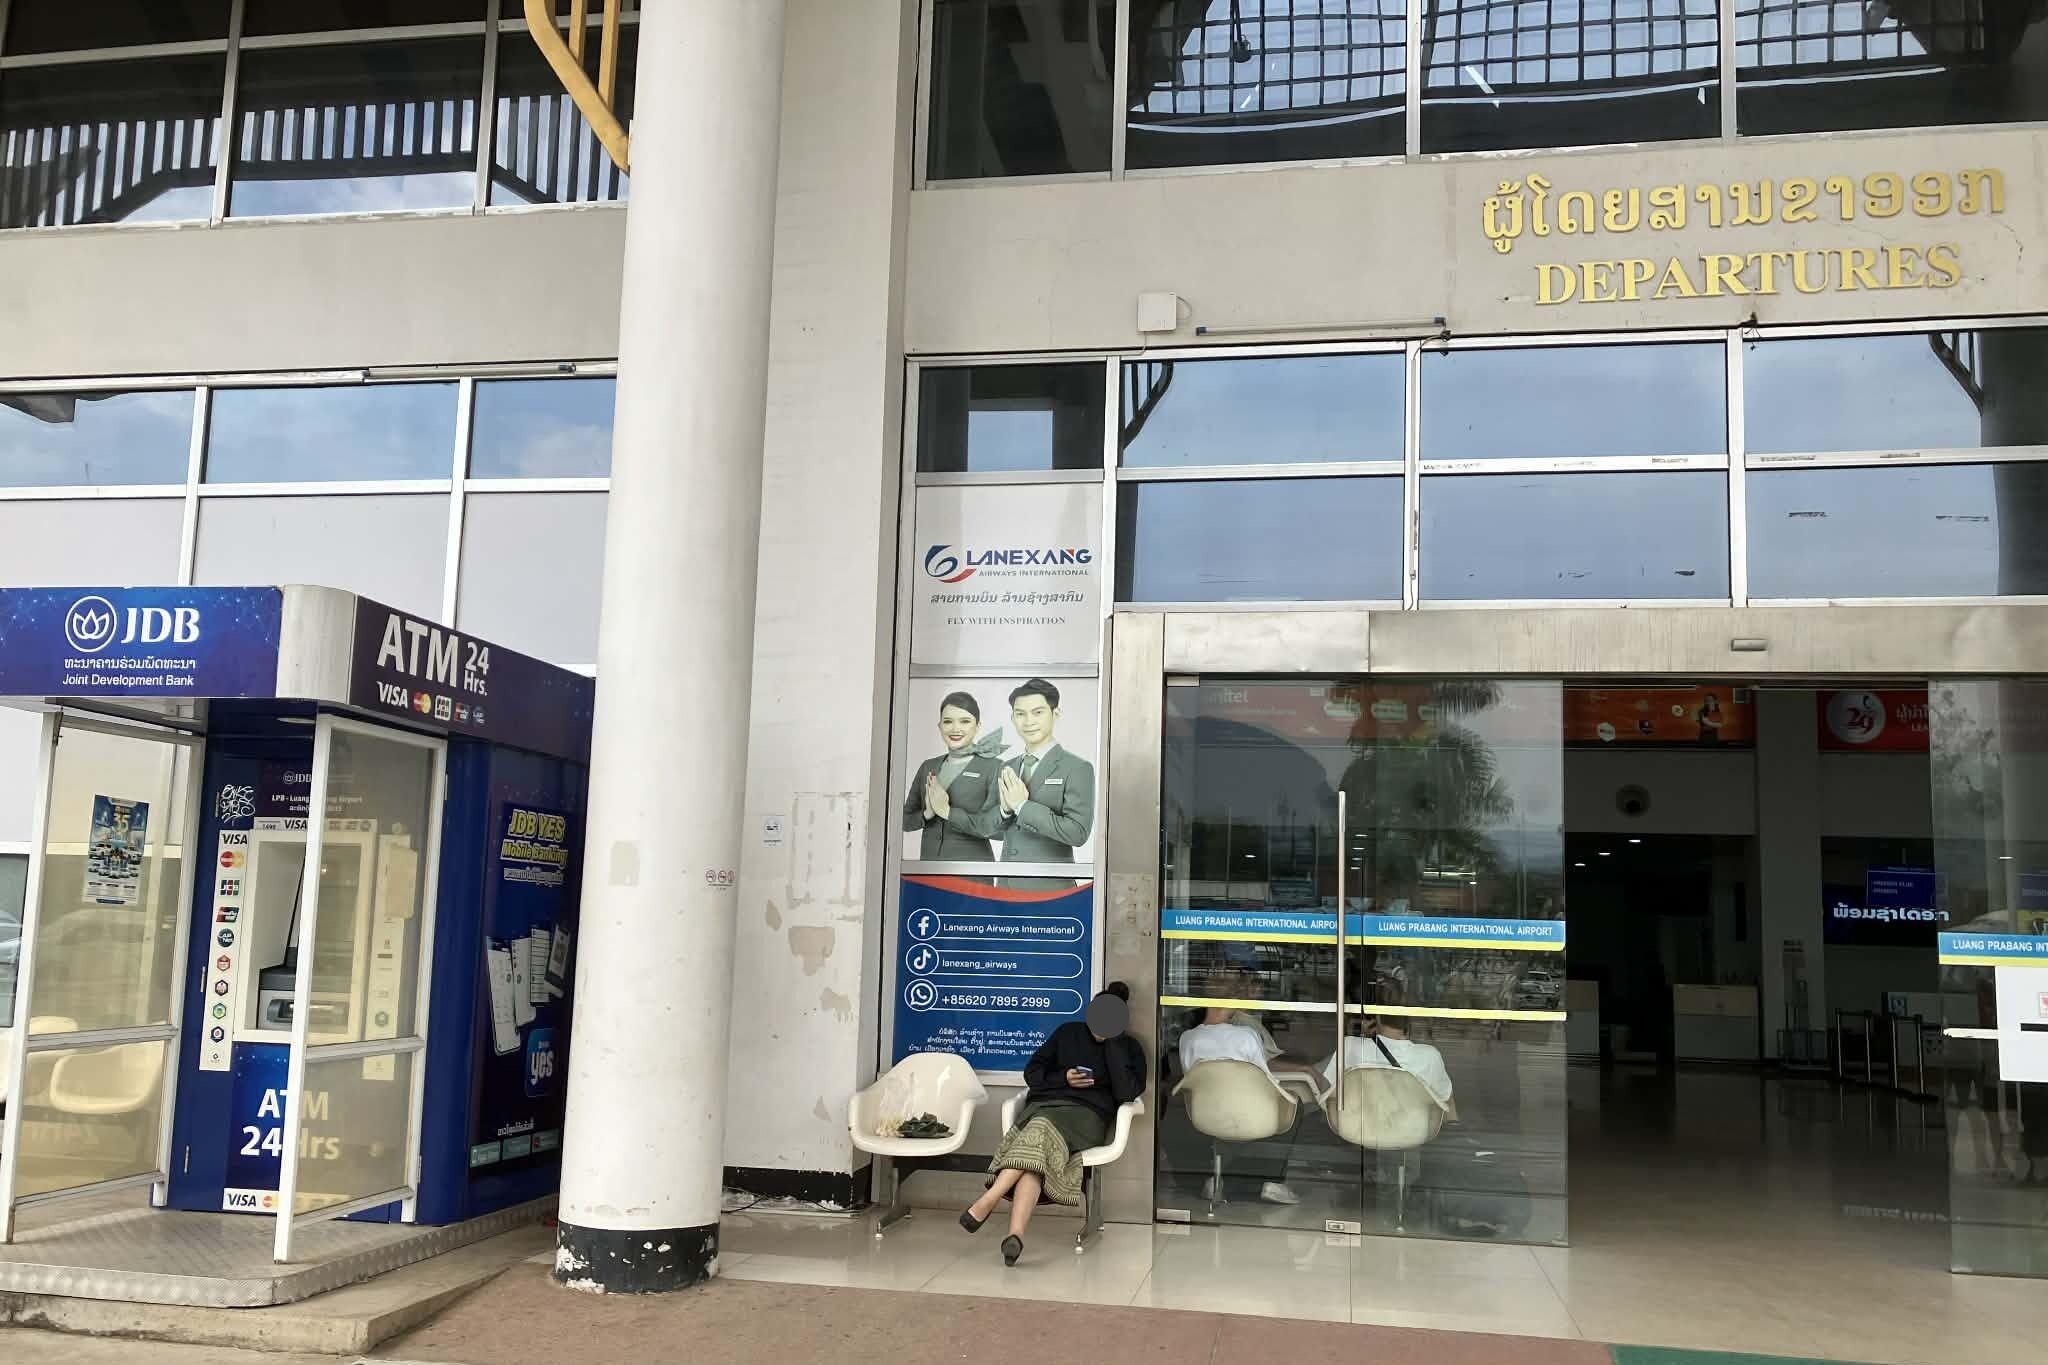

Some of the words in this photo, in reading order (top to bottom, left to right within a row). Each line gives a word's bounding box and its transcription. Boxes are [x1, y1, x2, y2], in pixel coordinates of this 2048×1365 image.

[1535, 243, 1964, 306] DEPARTURES
[966, 549, 1093, 566] LANEXANG
[1019, 569, 1089, 577] INTERNATIONAL
[121, 608, 200, 643] JDB
[947, 616, 967, 625] FLY
[968, 616, 996, 625] WITH
[999, 615, 1065, 625] INSPIRATION
[377, 613, 459, 688] ATM
[464, 641, 489, 675] 24
[63, 674, 88, 685] Joint
[91, 674, 163, 687] Development
[165, 675, 194, 686] Bank
[463, 670, 488, 696] Hrs.
[376, 681, 408, 708] VISA
[284, 819, 308, 830] VISA
[508, 809, 538, 838] JDB
[538, 814, 566, 842] YES
[222, 834, 248, 845] VISA
[1175, 915, 1203, 925] LUANG
[1205, 917, 1243, 927] PRABANG
[1245, 918, 1308, 929] INTERNATIONAL
[1378, 922, 1407, 931] LUANG
[1408, 923, 1448, 933] PRABANG
[1450, 924, 1514, 935] INTERNATIONAL
[1517, 927, 1553, 936] AIRPORT
[943, 924, 985, 934] Lanexang
[985, 924, 1020, 935] Airways
[1021, 926, 1075, 935] International
[1953, 939, 1985, 950] LUANG
[1987, 941, 2033, 952] PRABANG
[942, 958, 1017, 970] lanexang_airways
[942, 994, 987, 1006] +85620
[990, 996, 1018, 1007] 7895
[1021, 997, 1050, 1008] 2999
[257, 1088, 329, 1121] AM
[240, 1126, 282, 1157] 24
[228, 1193, 257, 1207] VISA
